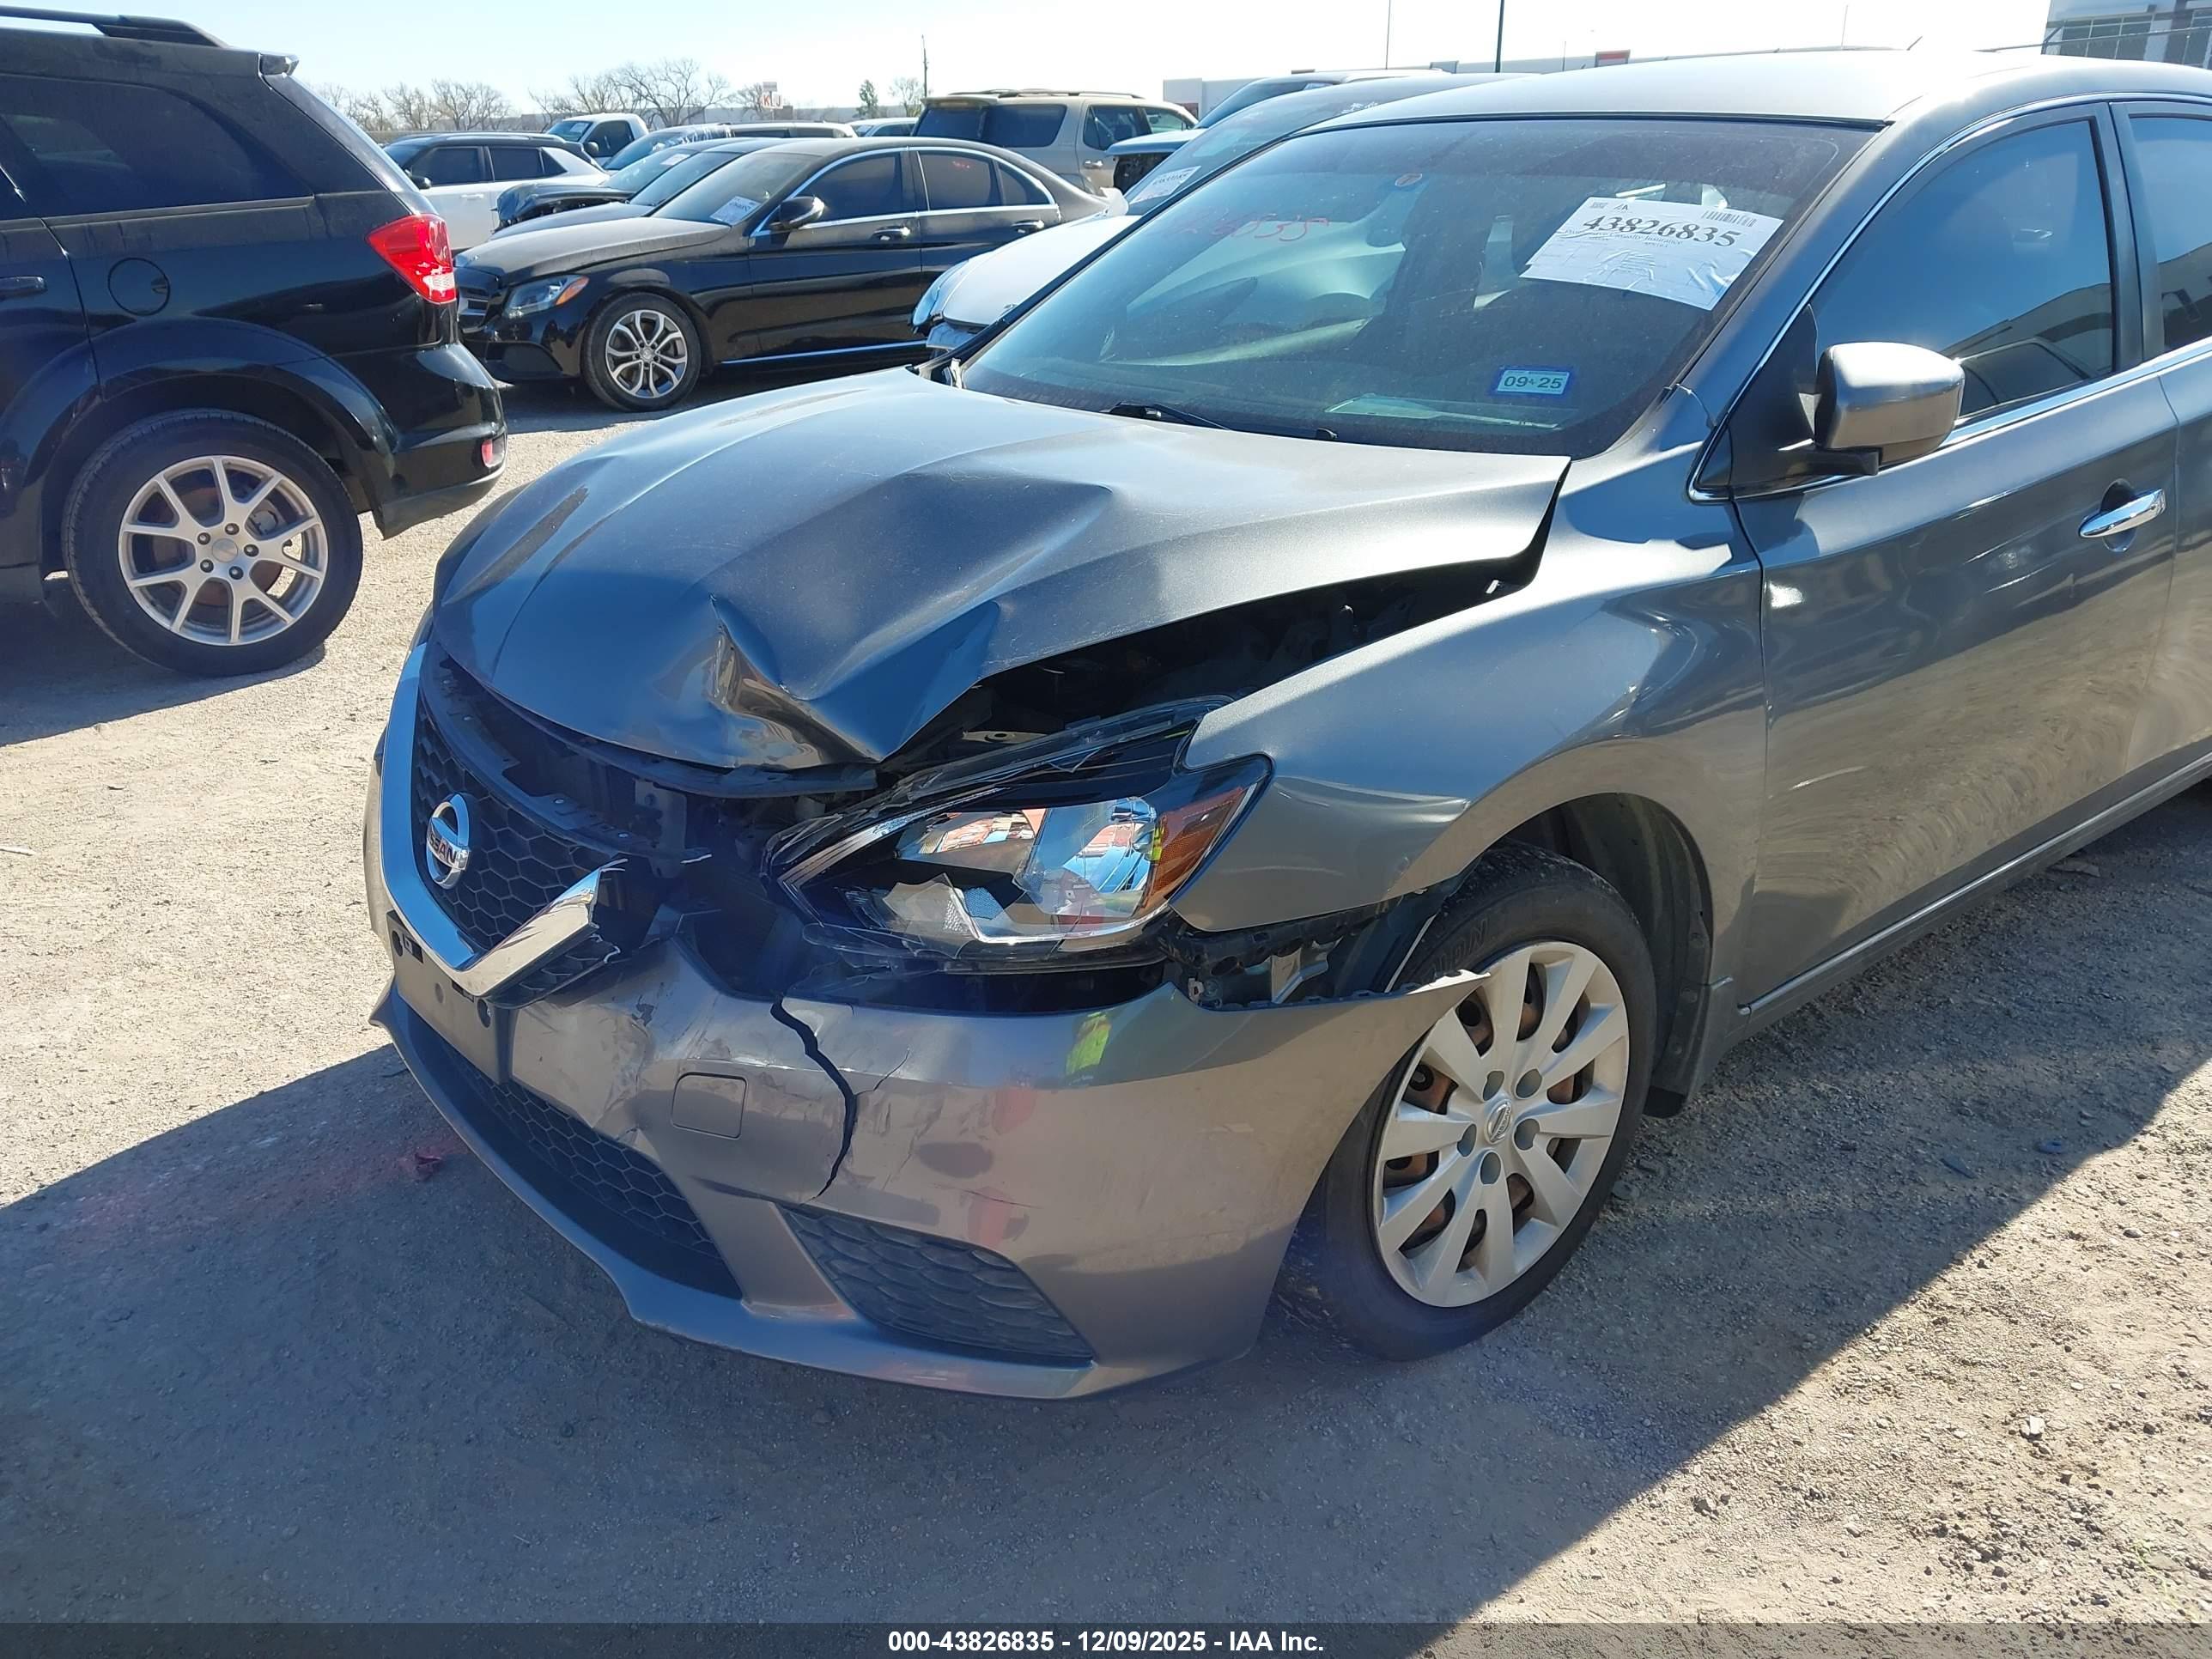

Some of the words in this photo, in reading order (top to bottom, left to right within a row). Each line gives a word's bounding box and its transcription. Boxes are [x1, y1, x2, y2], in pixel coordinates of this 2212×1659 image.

[1583, 215, 1741, 247] 43826835
[1504, 375, 1528, 388] 09
[1536, 376, 1564, 389] 25
